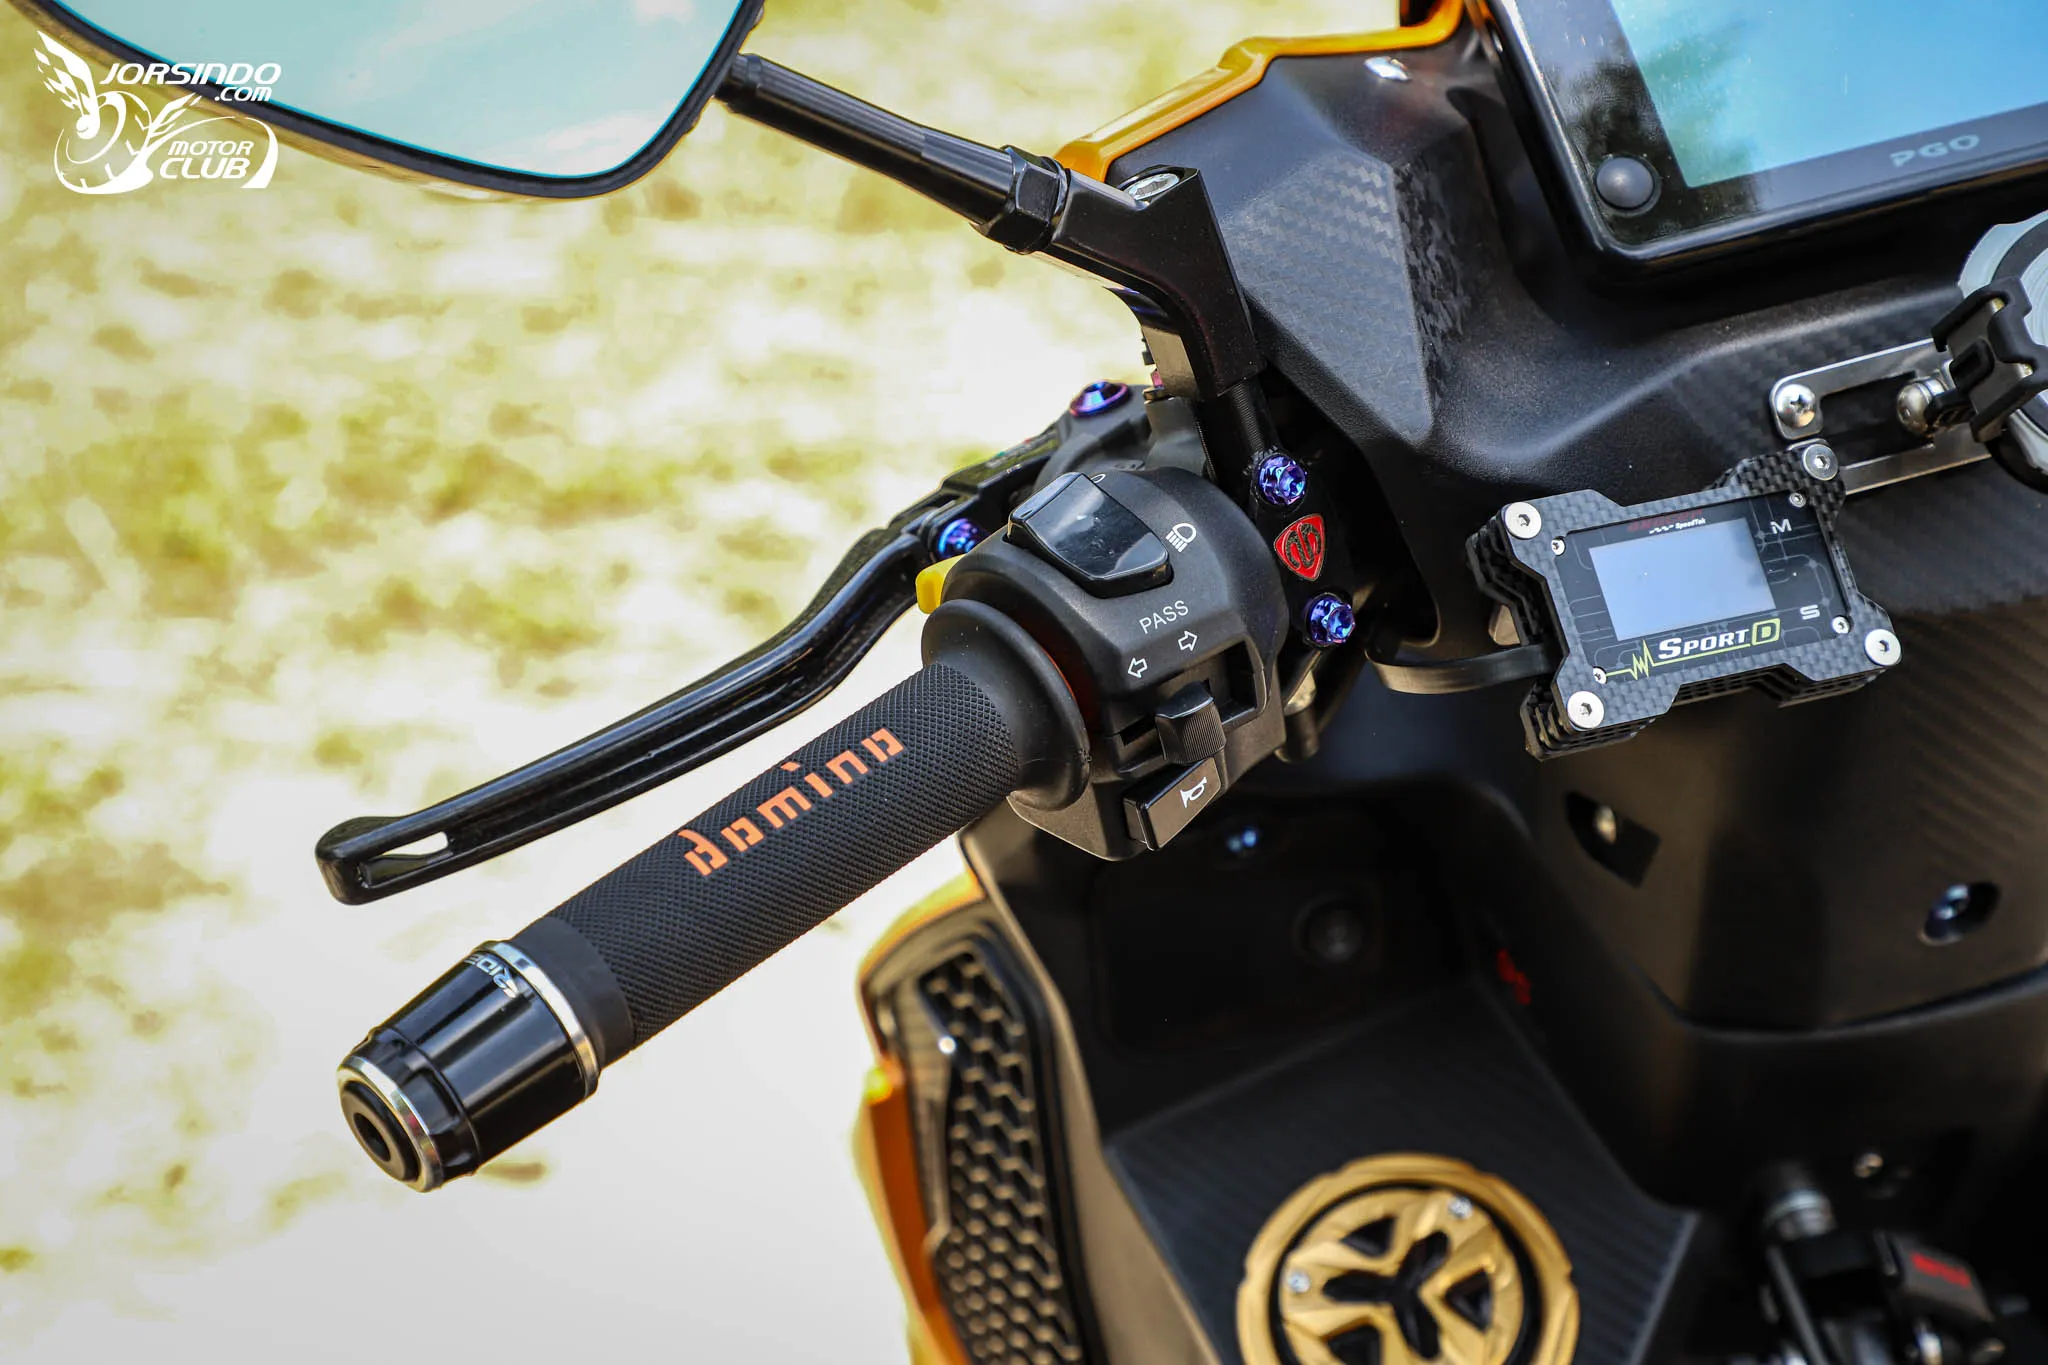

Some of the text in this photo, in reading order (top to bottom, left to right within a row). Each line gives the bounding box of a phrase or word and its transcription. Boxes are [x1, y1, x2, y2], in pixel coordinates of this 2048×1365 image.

[1890, 133, 1980, 169] PGO
[1770, 518, 1792, 534] M
[1138, 600, 1189, 635] PASS
[1799, 604, 1821, 620] S
[677, 727, 905, 876] domino
